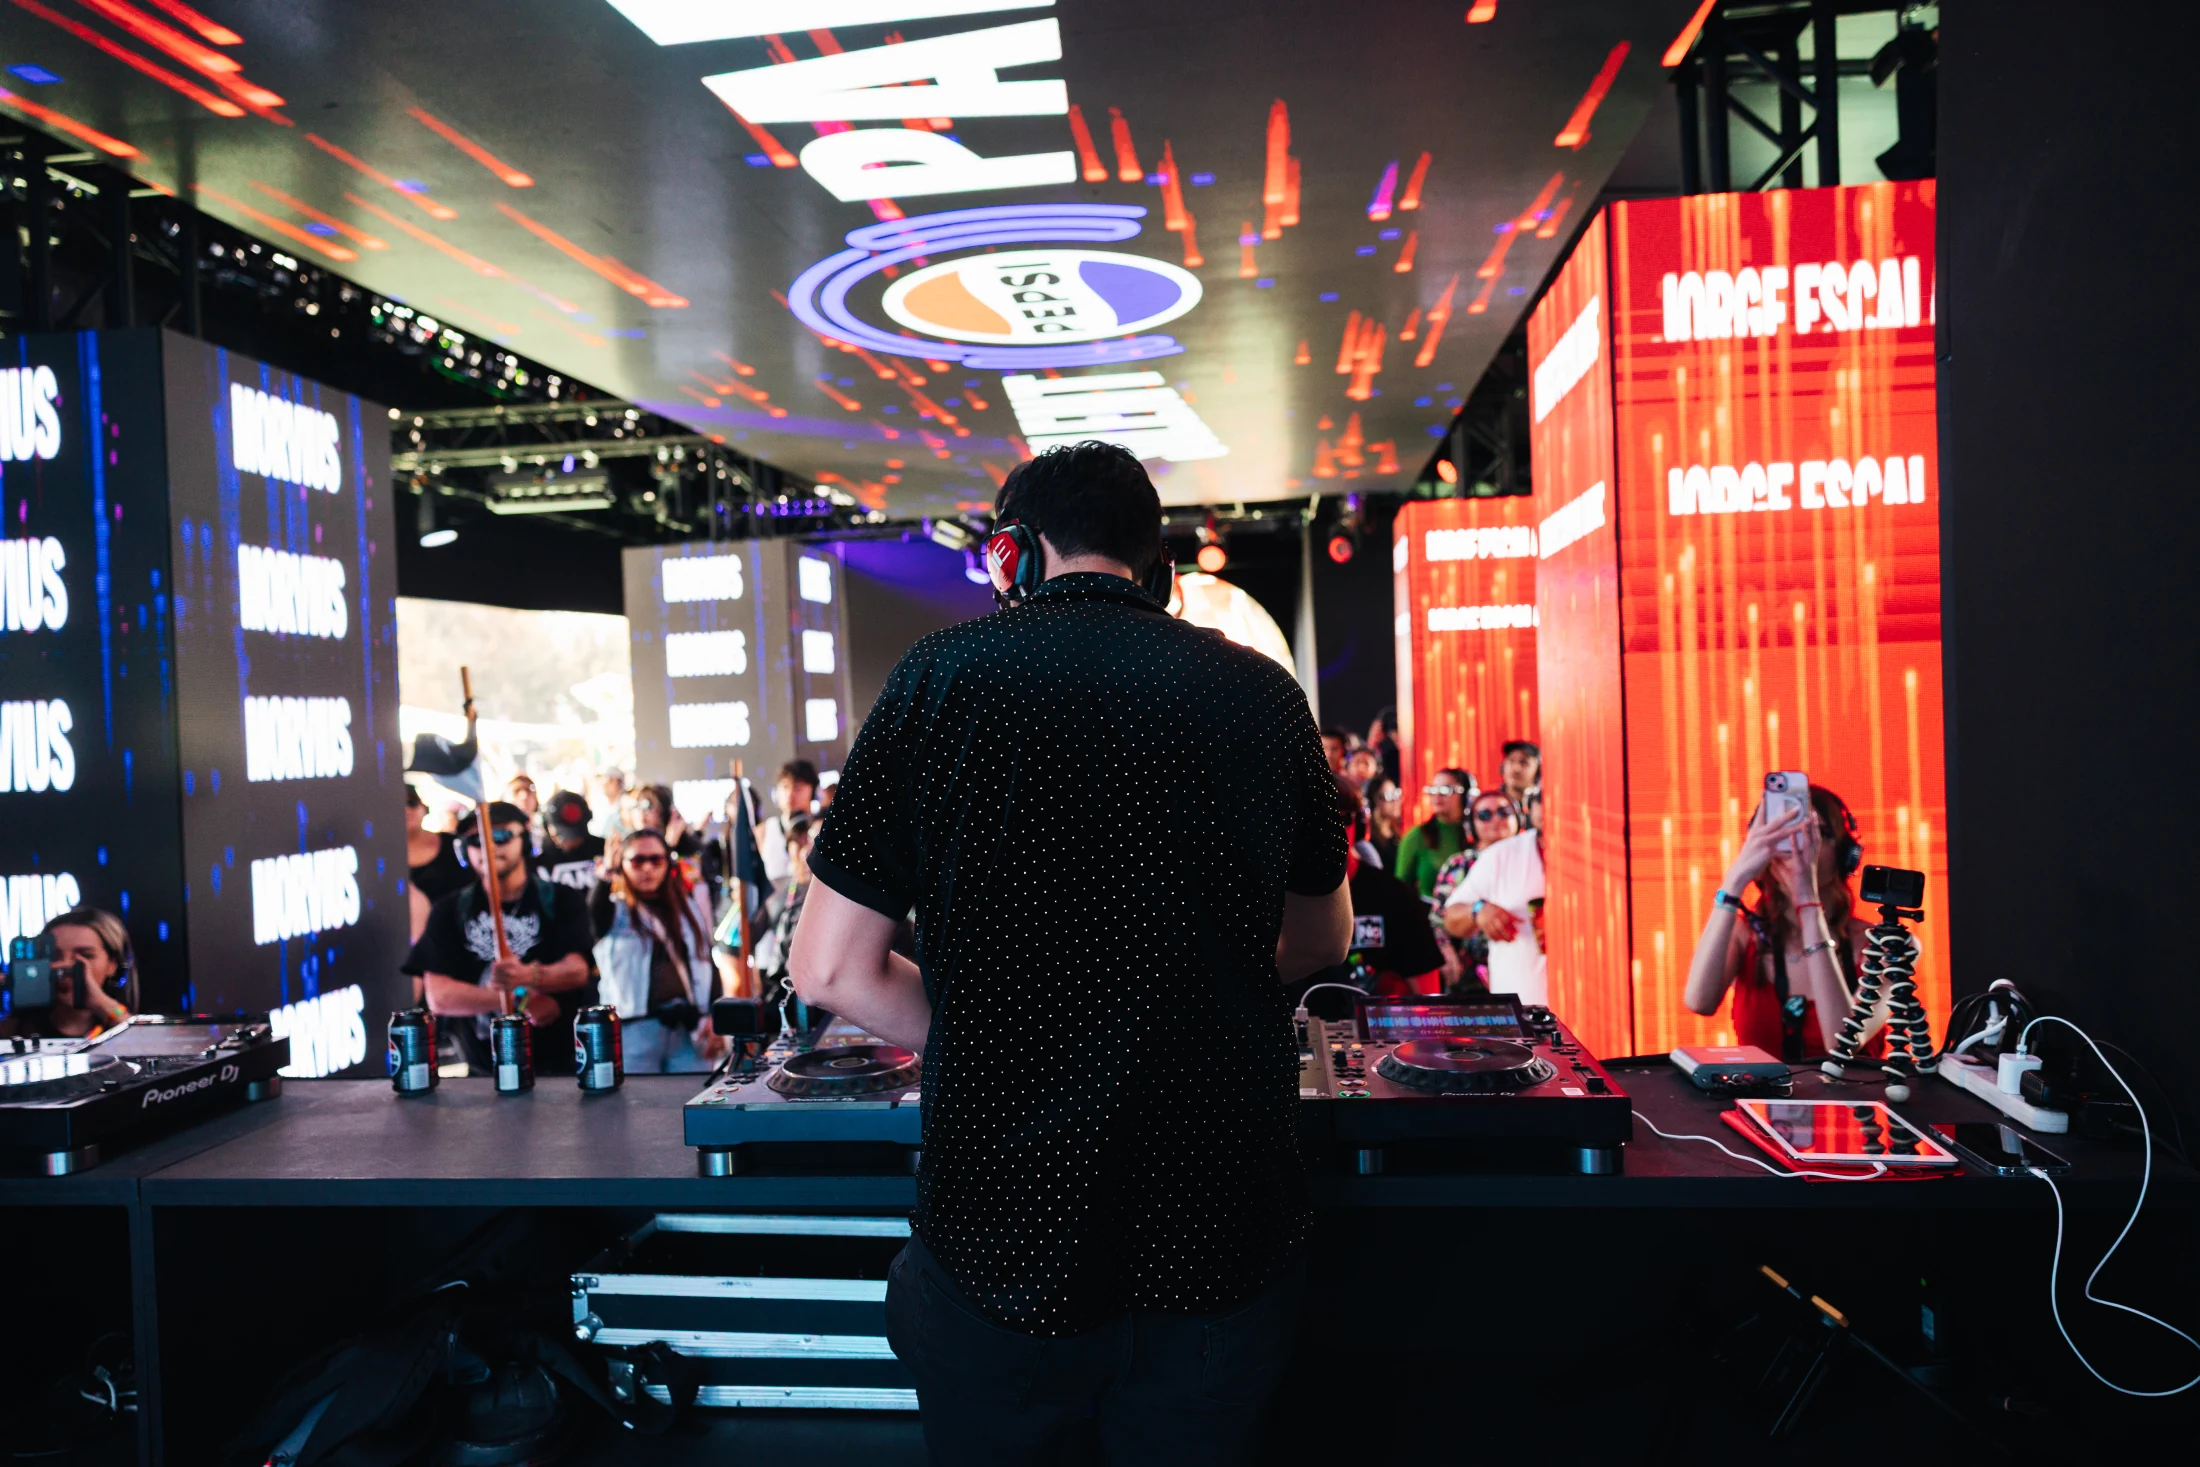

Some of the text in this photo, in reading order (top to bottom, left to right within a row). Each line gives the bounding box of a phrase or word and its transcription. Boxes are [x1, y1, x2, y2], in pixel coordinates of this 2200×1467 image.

[605, 0, 1078, 202] PA
[996, 262, 1085, 333] PEPSI
[1794, 256, 1936, 334] ESCAL
[269, 984, 367, 1078] ORVIUS
[142, 1073, 217, 1109] Pioneer
